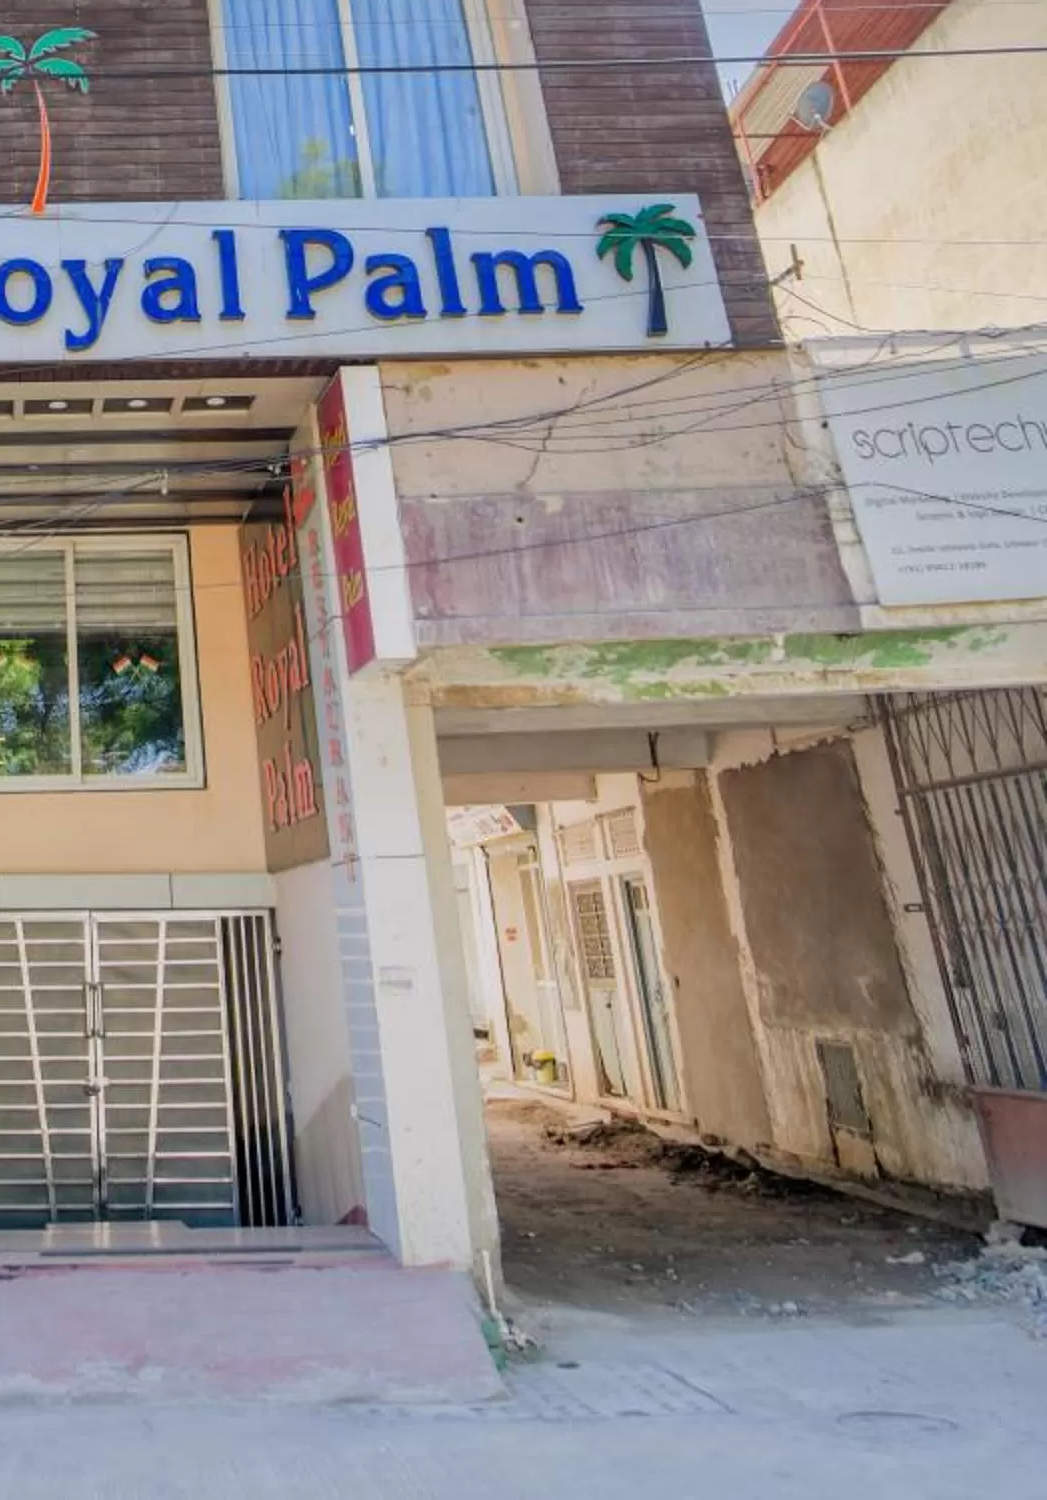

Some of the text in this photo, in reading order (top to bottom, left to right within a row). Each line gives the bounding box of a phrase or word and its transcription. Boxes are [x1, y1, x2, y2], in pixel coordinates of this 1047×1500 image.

[281, 226, 585, 320] Palm
[852, 412, 1047, 466] scriptech
[244, 483, 299, 618] Hotel
[251, 603, 311, 730] Royal
[264, 752, 319, 831] Palm
